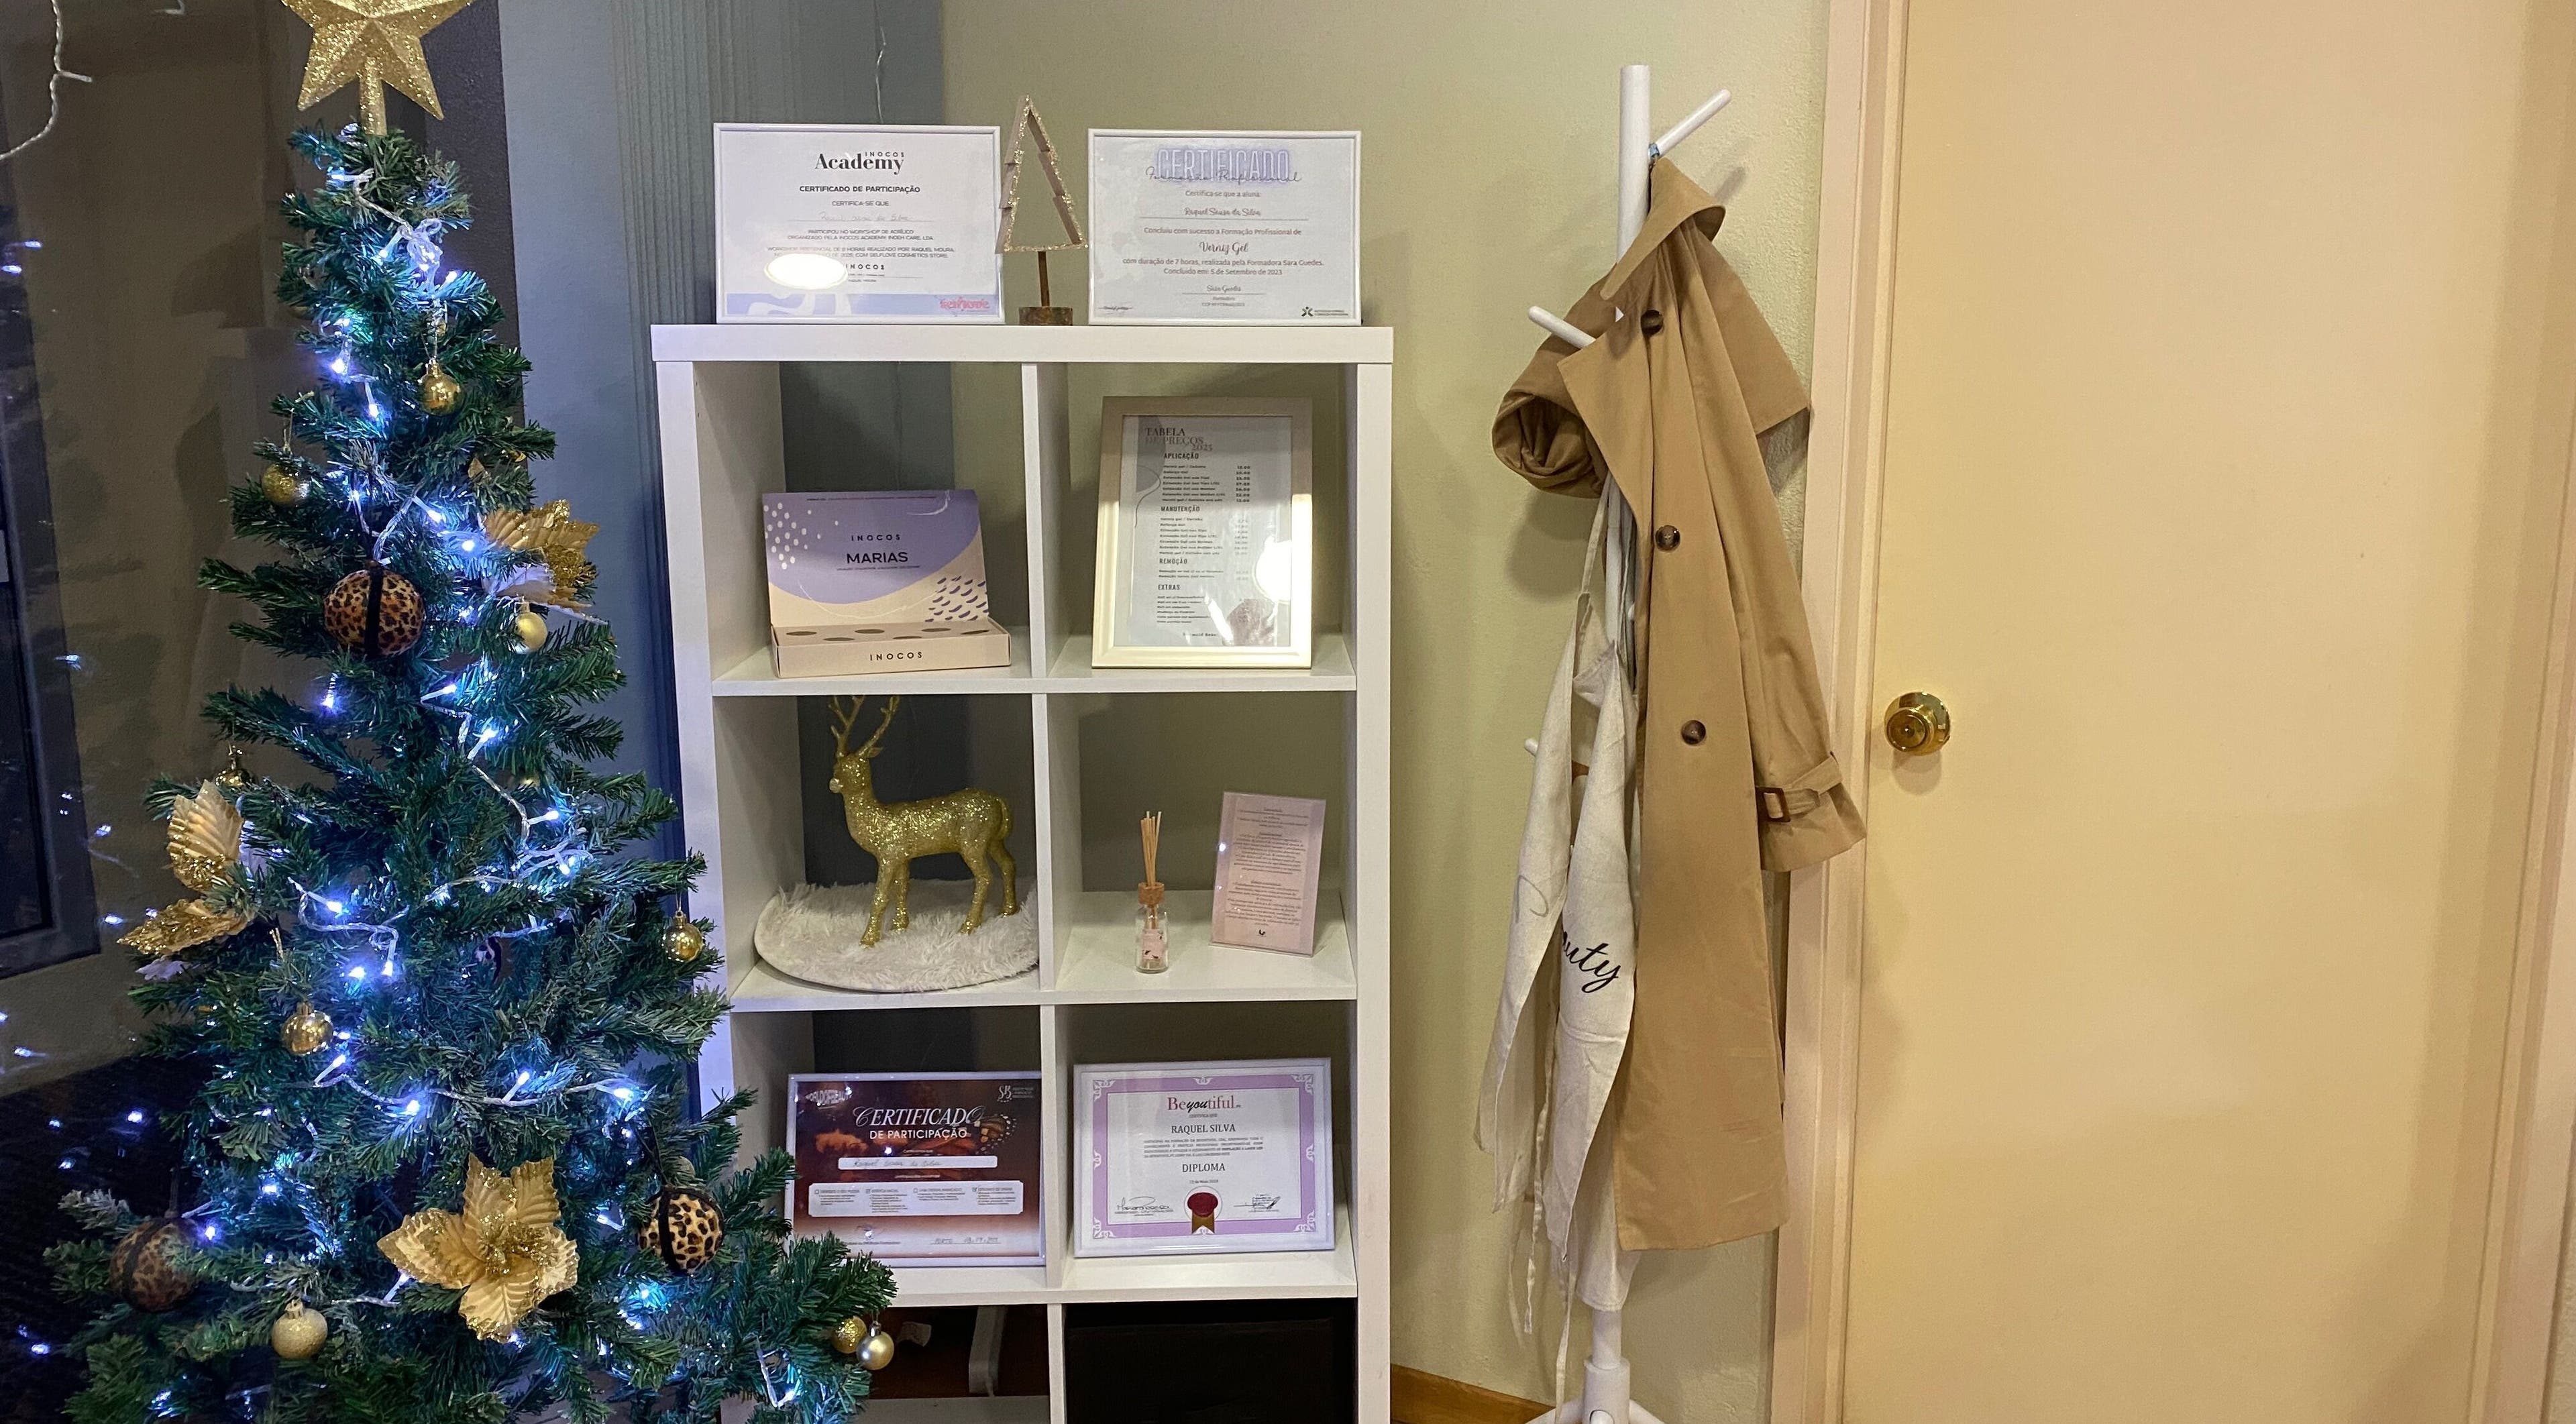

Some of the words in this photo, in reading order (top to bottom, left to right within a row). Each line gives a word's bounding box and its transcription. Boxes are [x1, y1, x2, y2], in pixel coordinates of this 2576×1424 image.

[814, 153, 904, 175] Academy
[1157, 149, 1289, 182] CERTIFICADO
[865, 185, 920, 194] PARTICIPAÇÃO
[1232, 241, 1249, 256] Gel
[1145, 428, 1185, 436] TABELA
[1164, 437, 1203, 446] PREÇOS
[1164, 452, 1199, 460] APLICAÇÃO
[1161, 504, 1200, 513] MANUTENÇÃO
[847, 551, 908, 563] MARIAS
[1159, 557, 1187, 565] REMOÇÃO
[870, 651, 922, 661] INOCOS
[853, 1105, 985, 1127] CERTIFICADO
[869, 1130, 883, 1140] DE
[888, 1128, 967, 1140] PARTICIPAÇÃO
[1171, 1125, 1208, 1135] RAQUEL
[1210, 1124, 1236, 1133] SILVA
[1182, 1163, 1225, 1172] DIPLOMA
